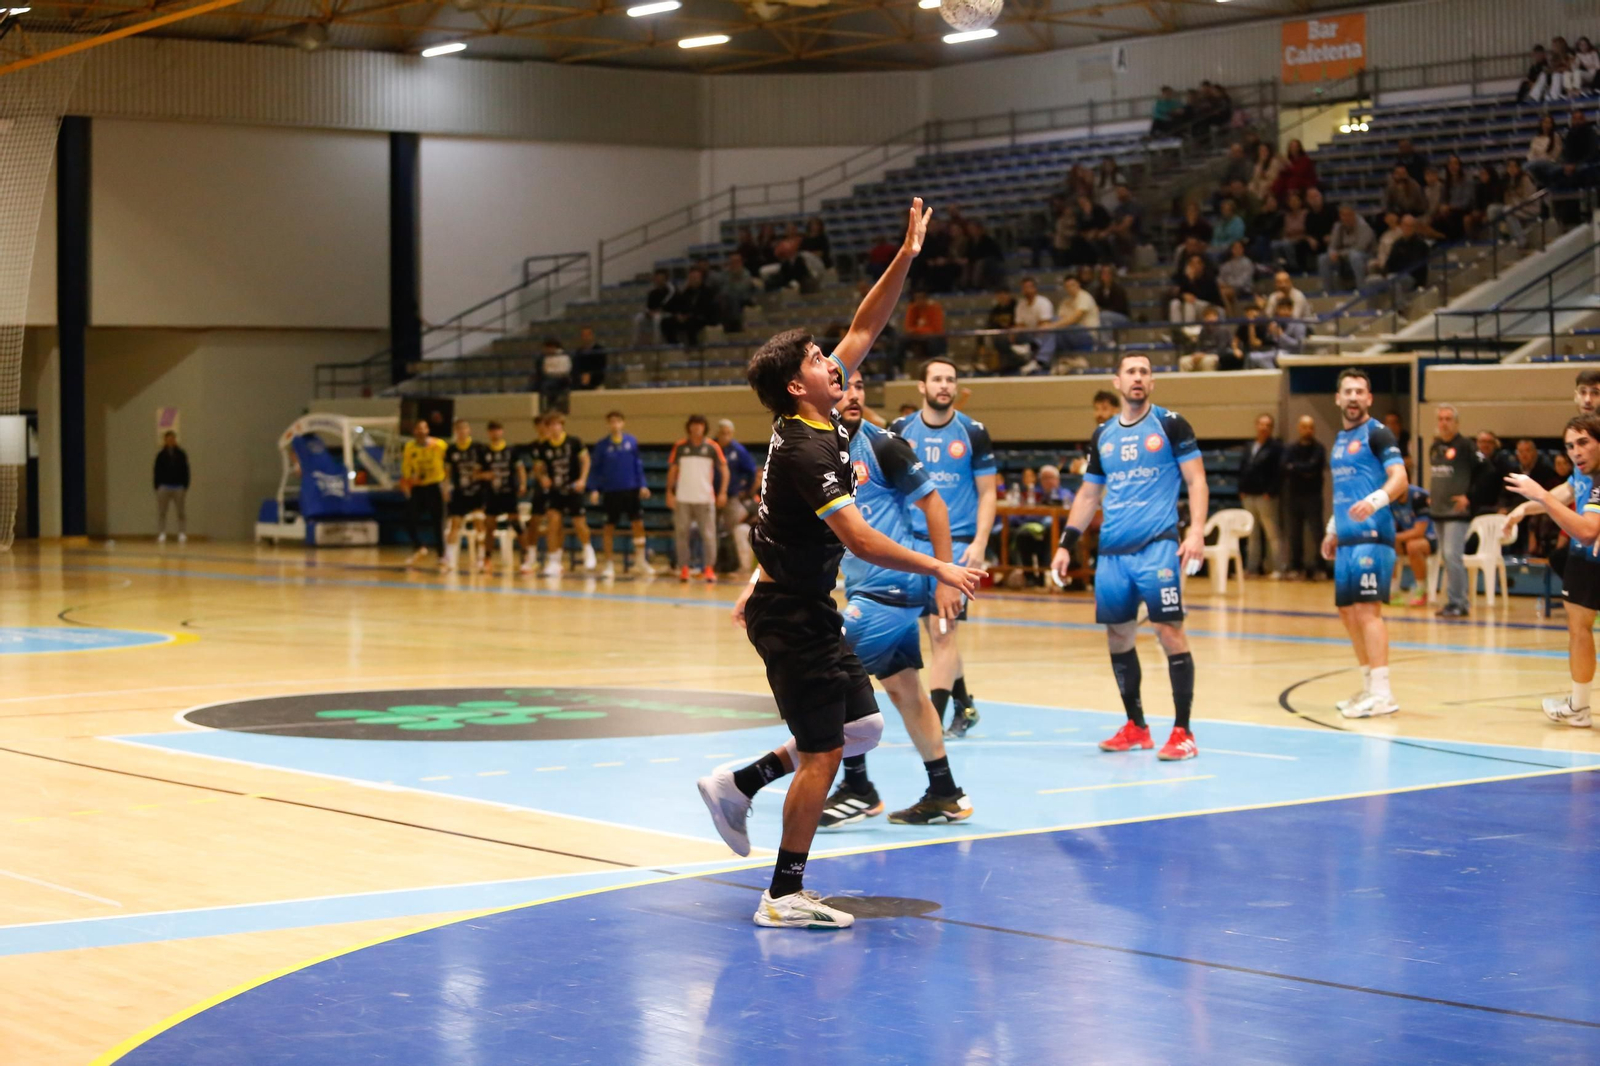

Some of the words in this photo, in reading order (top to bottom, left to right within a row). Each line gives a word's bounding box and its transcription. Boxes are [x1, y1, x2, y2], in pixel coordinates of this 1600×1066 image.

[1307, 20, 1339, 40] Bar
[924, 445, 940, 463] 10
[1121, 443, 1138, 462] 55
[1360, 572, 1378, 589] 44
[1160, 586, 1179, 606] 55
